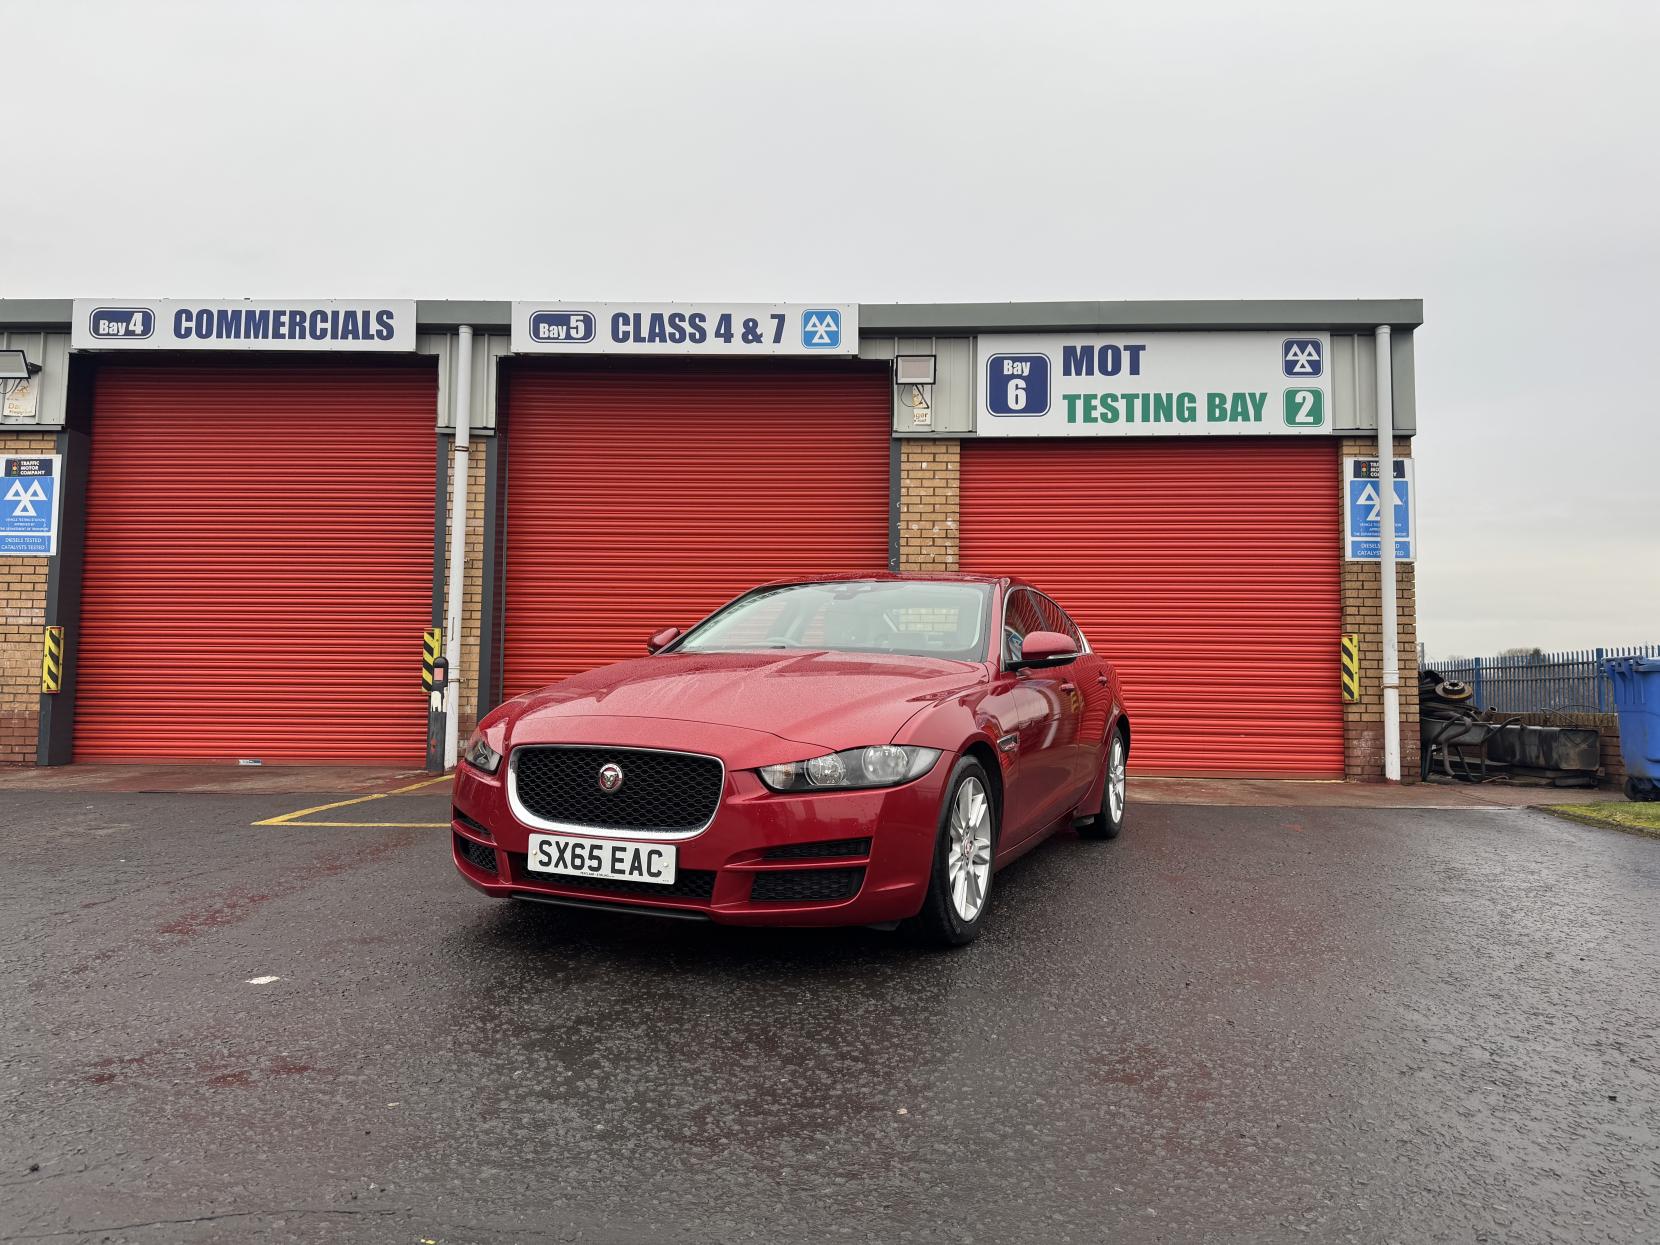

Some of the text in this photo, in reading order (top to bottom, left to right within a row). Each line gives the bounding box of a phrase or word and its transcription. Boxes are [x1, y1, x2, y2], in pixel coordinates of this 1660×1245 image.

[99, 312, 143, 336] Bay 4
[173, 308, 395, 341] COMMERCIALS
[539, 315, 584, 339] Bay 5
[610, 312, 786, 344] CLASS 4 & 7
[1003, 359, 1030, 376] Bay
[1062, 344, 1147, 376] MOT
[1007, 378, 1027, 410] 6
[1062, 390, 1314, 424] TESTING BAY 2
[538, 839, 663, 878] SX65 EAC
